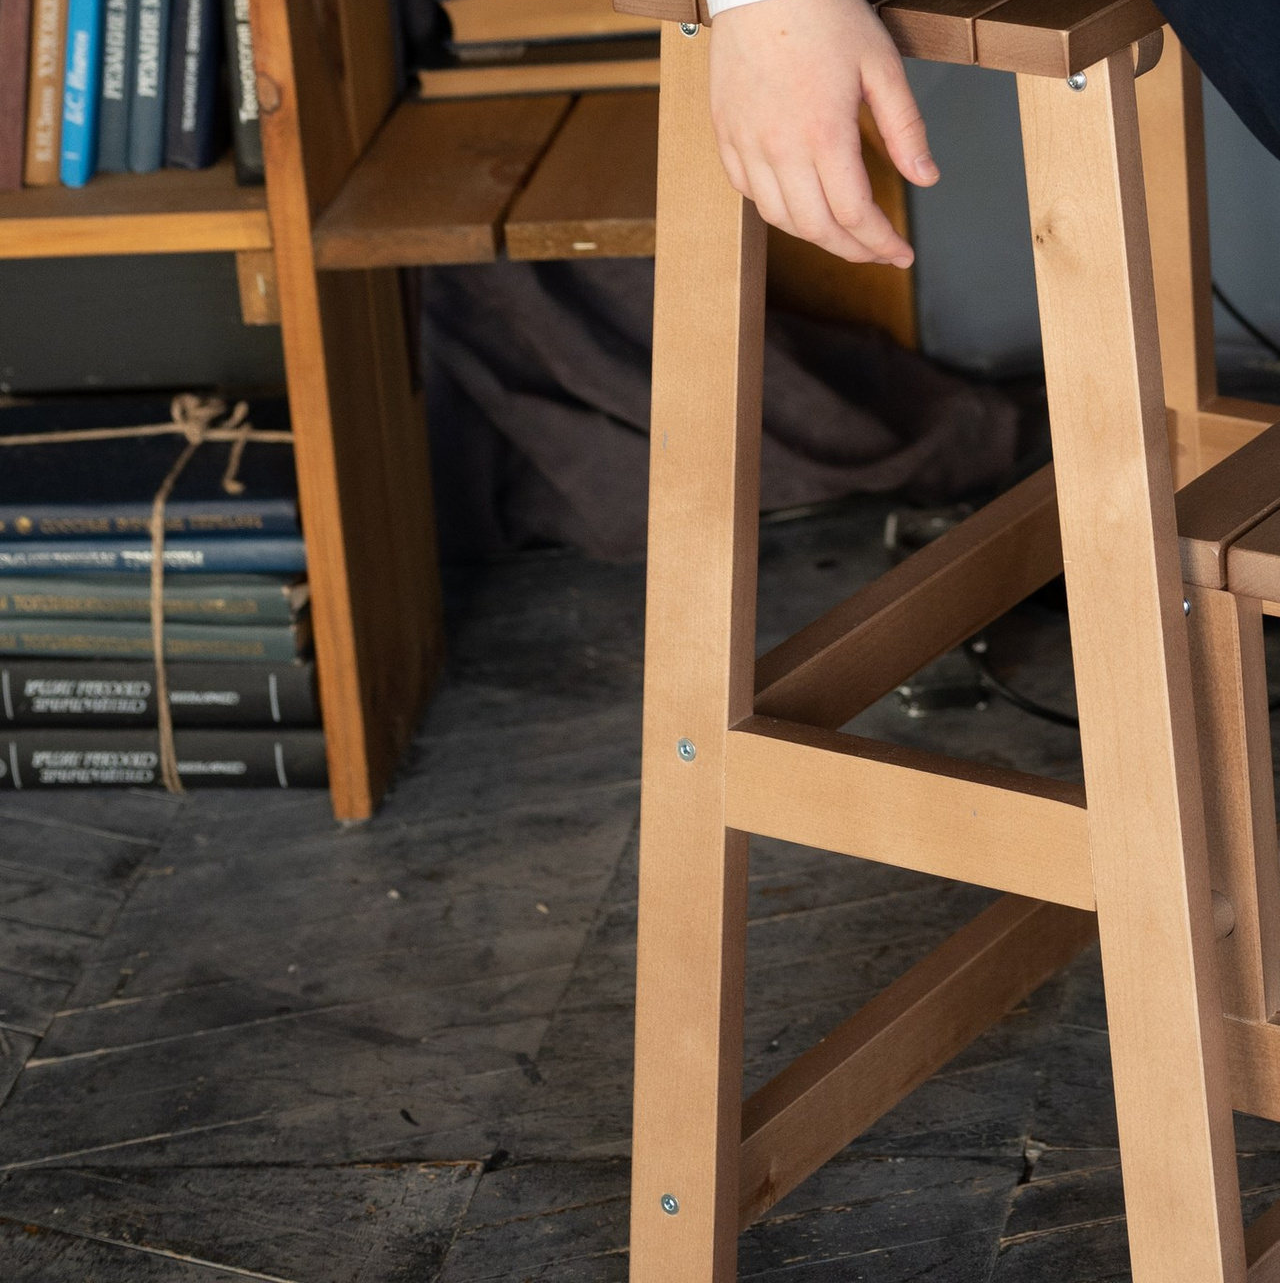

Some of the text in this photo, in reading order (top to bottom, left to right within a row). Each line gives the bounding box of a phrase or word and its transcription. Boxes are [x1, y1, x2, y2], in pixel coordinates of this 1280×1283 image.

[103, 11, 130, 100] РЕЗАНИЕ
[137, 9, 162, 98] РЕЗАНИЕ
[232, 23, 260, 124] Технология
